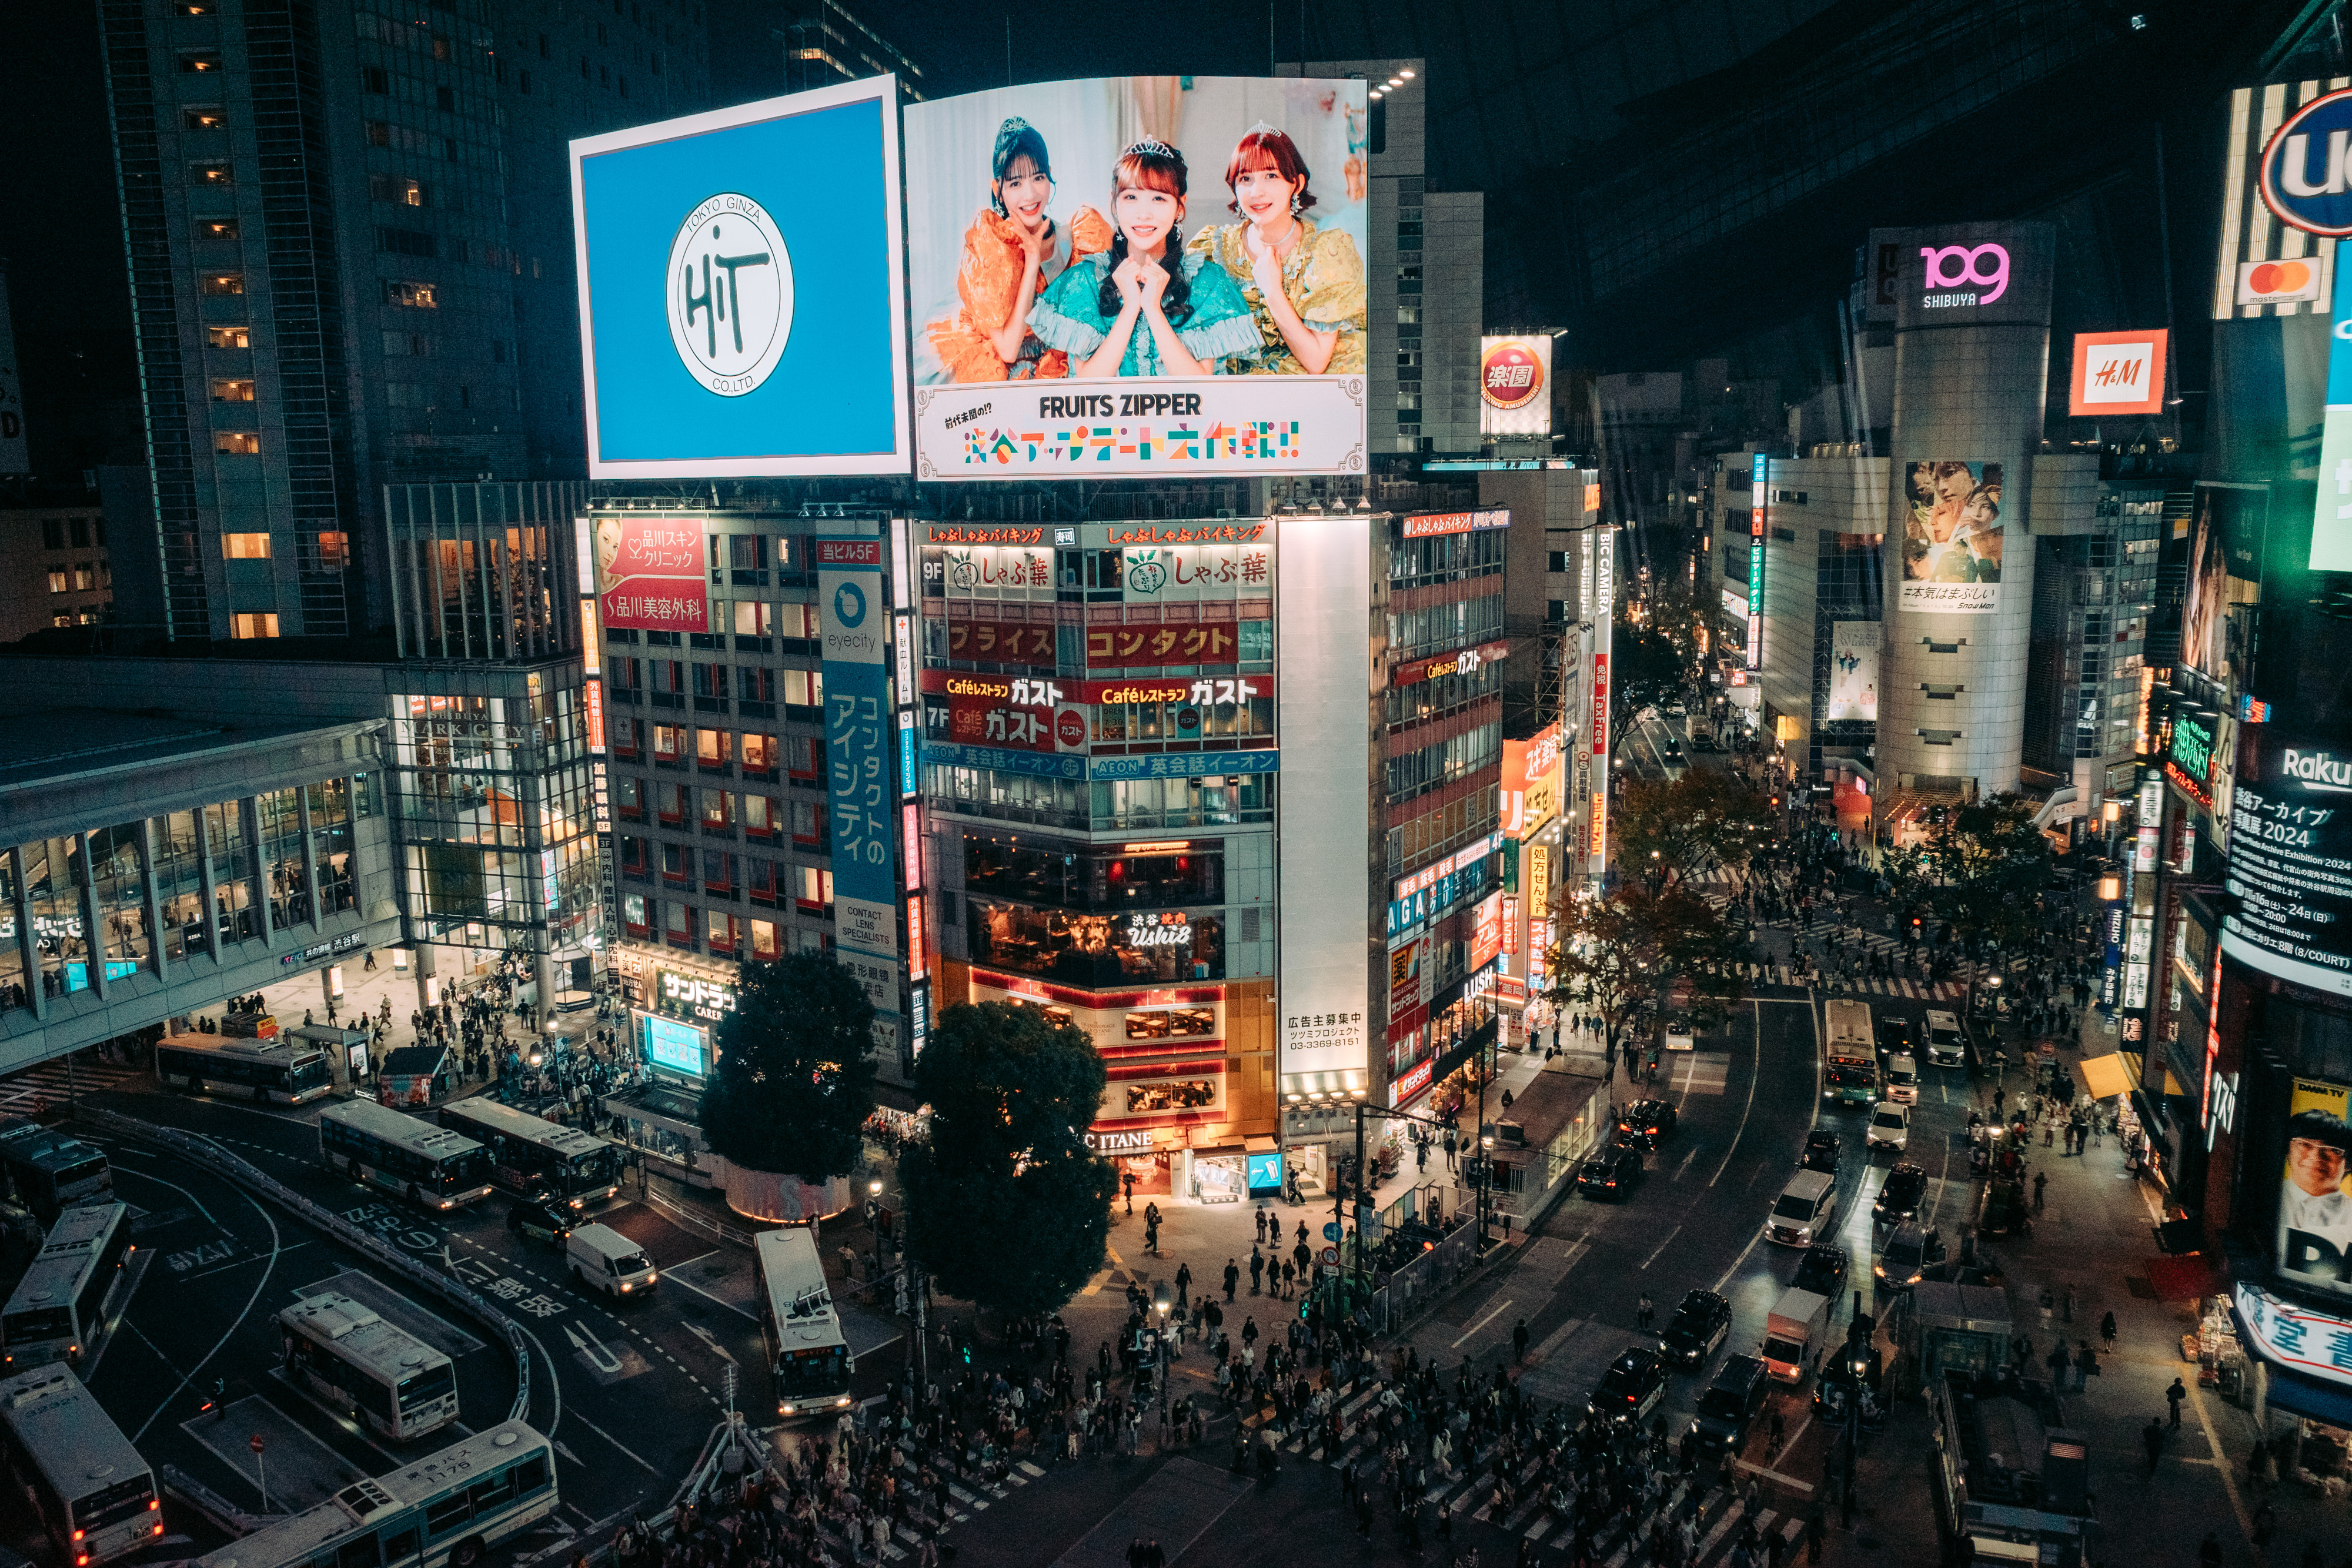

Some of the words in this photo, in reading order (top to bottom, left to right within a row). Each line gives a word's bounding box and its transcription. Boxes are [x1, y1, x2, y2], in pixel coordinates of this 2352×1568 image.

[686, 198, 720, 233] TOKYO
[726, 196, 761, 223] GINZA
[1920, 242, 2010, 305] 109
[1924, 293, 1977, 308] SHIBUYA
[1487, 365, 1534, 387] 楽園
[2095, 358, 2142, 387] H&M
[1040, 394, 1114, 419] FRUITS
[1120, 393, 1202, 416] ZIPPER
[1505, 385, 1540, 409] AMUSEMENT
[1756, 455, 1764, 467] THE
[1756, 468, 1765, 480] PRIME
[929, 526, 1043, 544] しゃぶしゃぶバイキング
[1108, 524, 1267, 544] しゃぶしゃぶバイキング
[1412, 513, 1472, 534] しゃぶしゃぶバイキング
[642, 530, 698, 549] 品川スキン
[1055, 531, 1074, 543] 寿司
[1600, 533, 1610, 556] BIC
[644, 550, 693, 568] クリニック
[823, 544, 874, 561] 当ビル5F
[924, 562, 942, 580] 9F
[983, 557, 1048, 587] しゃぶ葉
[1174, 551, 1268, 586] しゃぶ葉
[1599, 559, 1609, 614] CAMERA
[1903, 586, 1994, 600] #本気はまぶしい
[616, 596, 701, 622] 品川美容外科
[586, 611, 596, 666] 東京スター銀行
[828, 633, 876, 653] eyecity
[950, 625, 1055, 657] プライス
[1088, 627, 1234, 657] コンタクト
[899, 638, 908, 692] 献血ルーム
[1457, 650, 1481, 676] ガスト
[1596, 665, 1606, 685] 免税
[590, 682, 600, 717] 外貨両替
[1011, 678, 1064, 707] ガスト
[1191, 680, 1258, 706] ガスト
[927, 707, 949, 727] 7F
[956, 709, 983, 726] Café
[986, 708, 1048, 744] ガスト
[1595, 694, 1606, 744] TaxFree
[401, 721, 463, 735] MARK
[473, 724, 524, 738] CITY
[956, 726, 983, 736] レストラン
[1061, 726, 1083, 737] ガスト
[927, 746, 956, 758] AEON
[965, 748, 1057, 772] 英会話イーオン
[1097, 760, 1138, 774] AEON
[1150, 754, 1274, 775] 英会話イーオン
[1525, 734, 1557, 780] スギ薬局
[831, 694, 863, 862] アイシティ
[860, 697, 886, 865] コンタクトの
[1579, 770, 1587, 802] 調剤薬局
[594, 763, 609, 820] 加藤眼科
[2236, 787, 2327, 827] 渋谷アーカイブ
[1492, 831, 1504, 849] 4F
[2264, 821, 2309, 848] 2024
[907, 821, 916, 876] 品川美容外科
[2261, 843, 2284, 855] Archive
[2284, 850, 2323, 865] Exhibition
[2325, 858, 2351, 870] 2024
[602, 864, 613, 882] 内科
[1420, 868, 1435, 887] 抜毛
[1439, 859, 1453, 876] 発毛
[1534, 848, 1546, 897] 処方せん
[1401, 880, 1416, 898] 薄毛
[848, 907, 882, 920] CONTACT
[910, 898, 919, 938] 外貨両替
[1132, 914, 1158, 927] 渋谷
[1161, 912, 1186, 925] 焼肉
[1388, 892, 1424, 932] AGA
[843, 927, 890, 944] SPECIALISTS
[856, 920, 874, 930] LENS
[1127, 925, 1191, 946] Ushi8
[1477, 921, 1496, 947] アコム
[2111, 909, 2122, 943] MIZUHO
[283, 952, 303, 963] KEIO
[306, 944, 330, 957] 井の頭線
[334, 933, 360, 949] 渋谷駅
[1483, 949, 1490, 959] 3F
[1531, 923, 1544, 971] スギ薬局
[2278, 941, 2293, 955] 8階
[2295, 945, 2350, 968] (8/COURT)
[633, 964, 642, 974] 2F
[1394, 954, 1406, 984] 薬
[1392, 990, 1401, 999] DRUG
[1404, 978, 1419, 992] COSMETIC
[1464, 965, 1492, 1003] LUSH
[1392, 988, 1419, 1015] サンドラッグ
[1288, 1011, 1362, 1030] 広告主募集中
[1290, 1027, 1359, 1040] ツツミプロジェクト
[1290, 1037, 1359, 1051] 03-3369-8151
[1407, 1064, 1430, 1088] サンドラッグ
[406, 1449, 473, 1481] 東急バス
[426, 1461, 471, 1483] 1175
